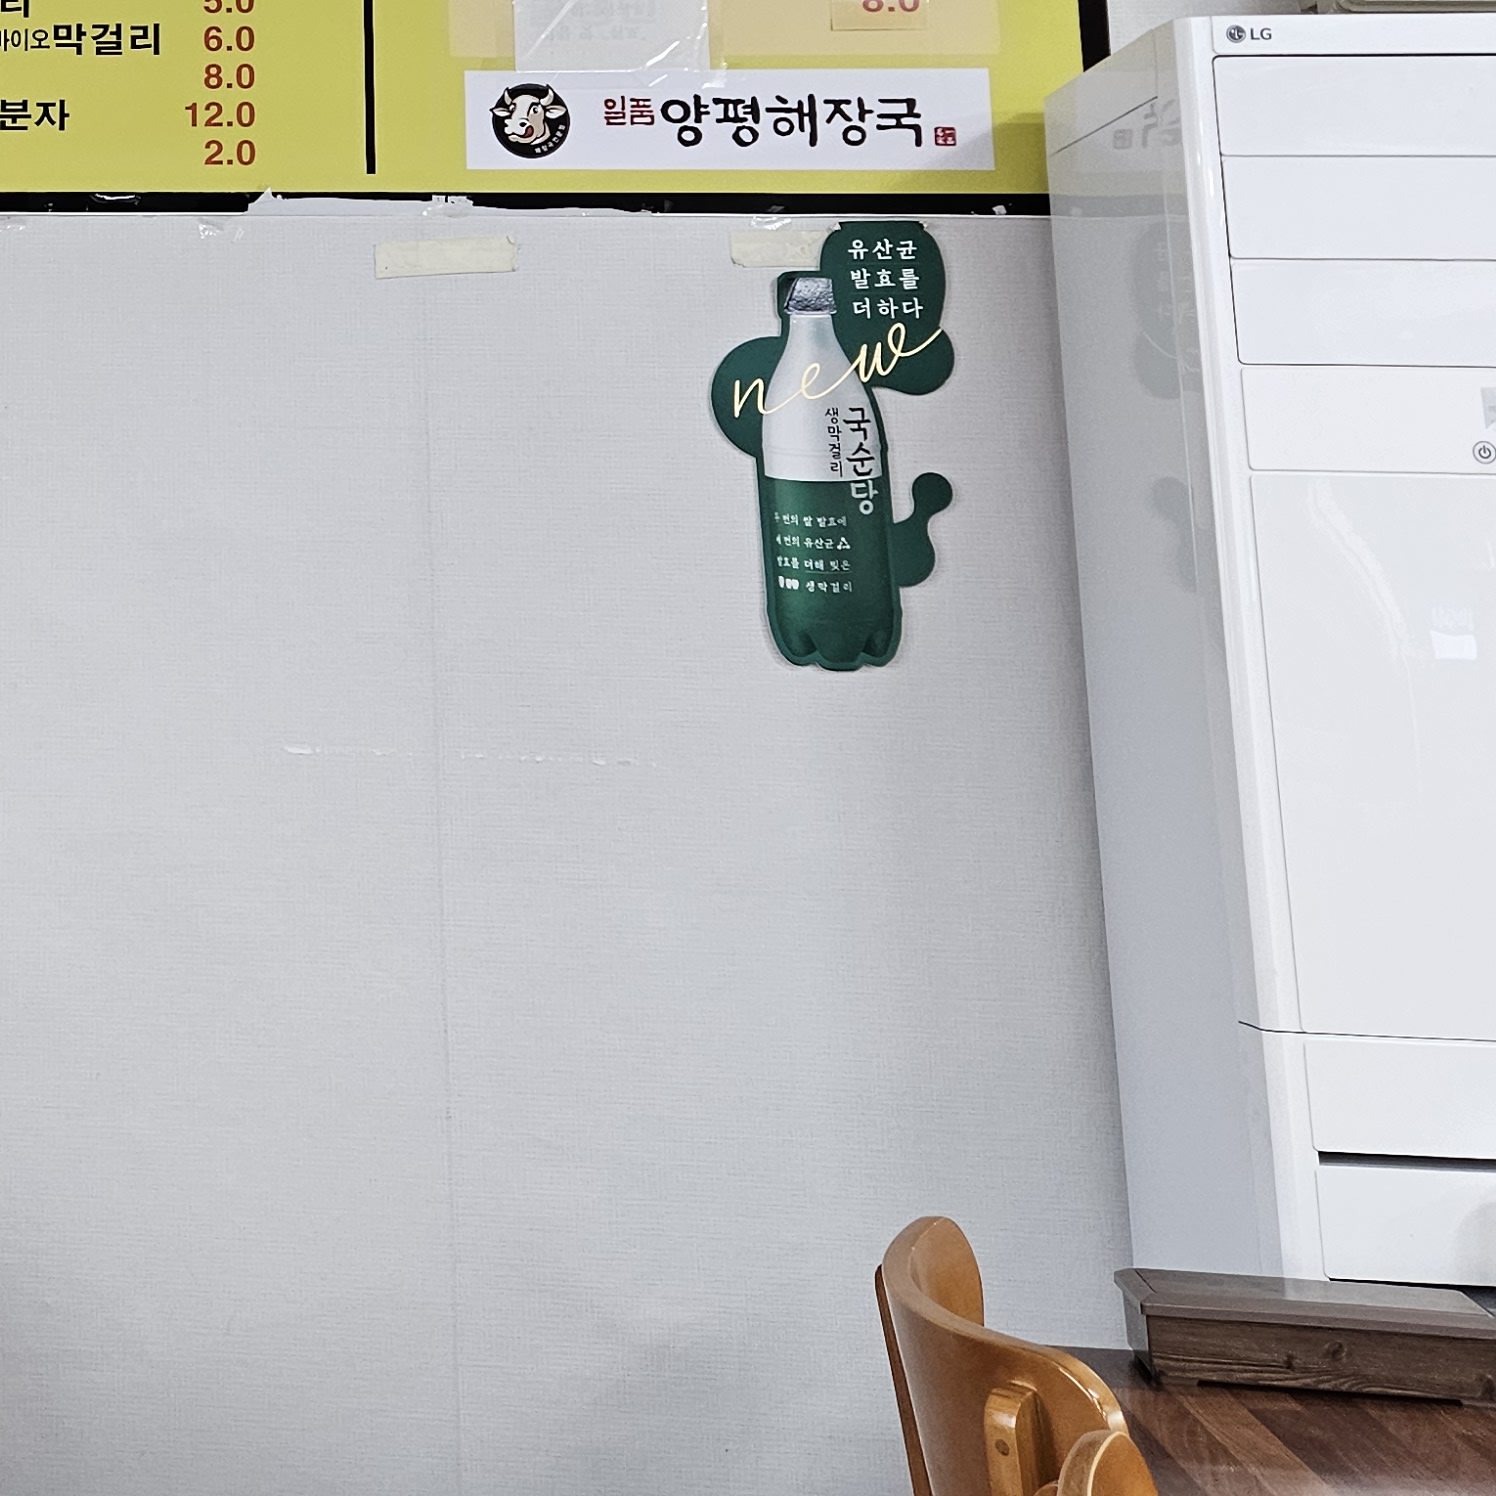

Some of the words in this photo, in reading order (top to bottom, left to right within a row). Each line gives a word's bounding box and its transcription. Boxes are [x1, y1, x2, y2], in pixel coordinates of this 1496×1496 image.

[203, 25, 255, 53] 6.0
[1250, 28, 1272, 41] LG
[203, 63, 256, 90] 8.0
[183, 101, 256, 128] 12.0
[604, 94, 655, 126] 일품
[660, 94, 922, 148] 양평해장국
[204, 139, 257, 166] 2.0
[847, 239, 918, 260] 유산균
[850, 268, 920, 290] 발효를
[853, 297, 923, 320] 더하다
[733, 322, 942, 418] new
[825, 407, 844, 477] 생막걸리
[843, 407, 879, 515] 국순당
